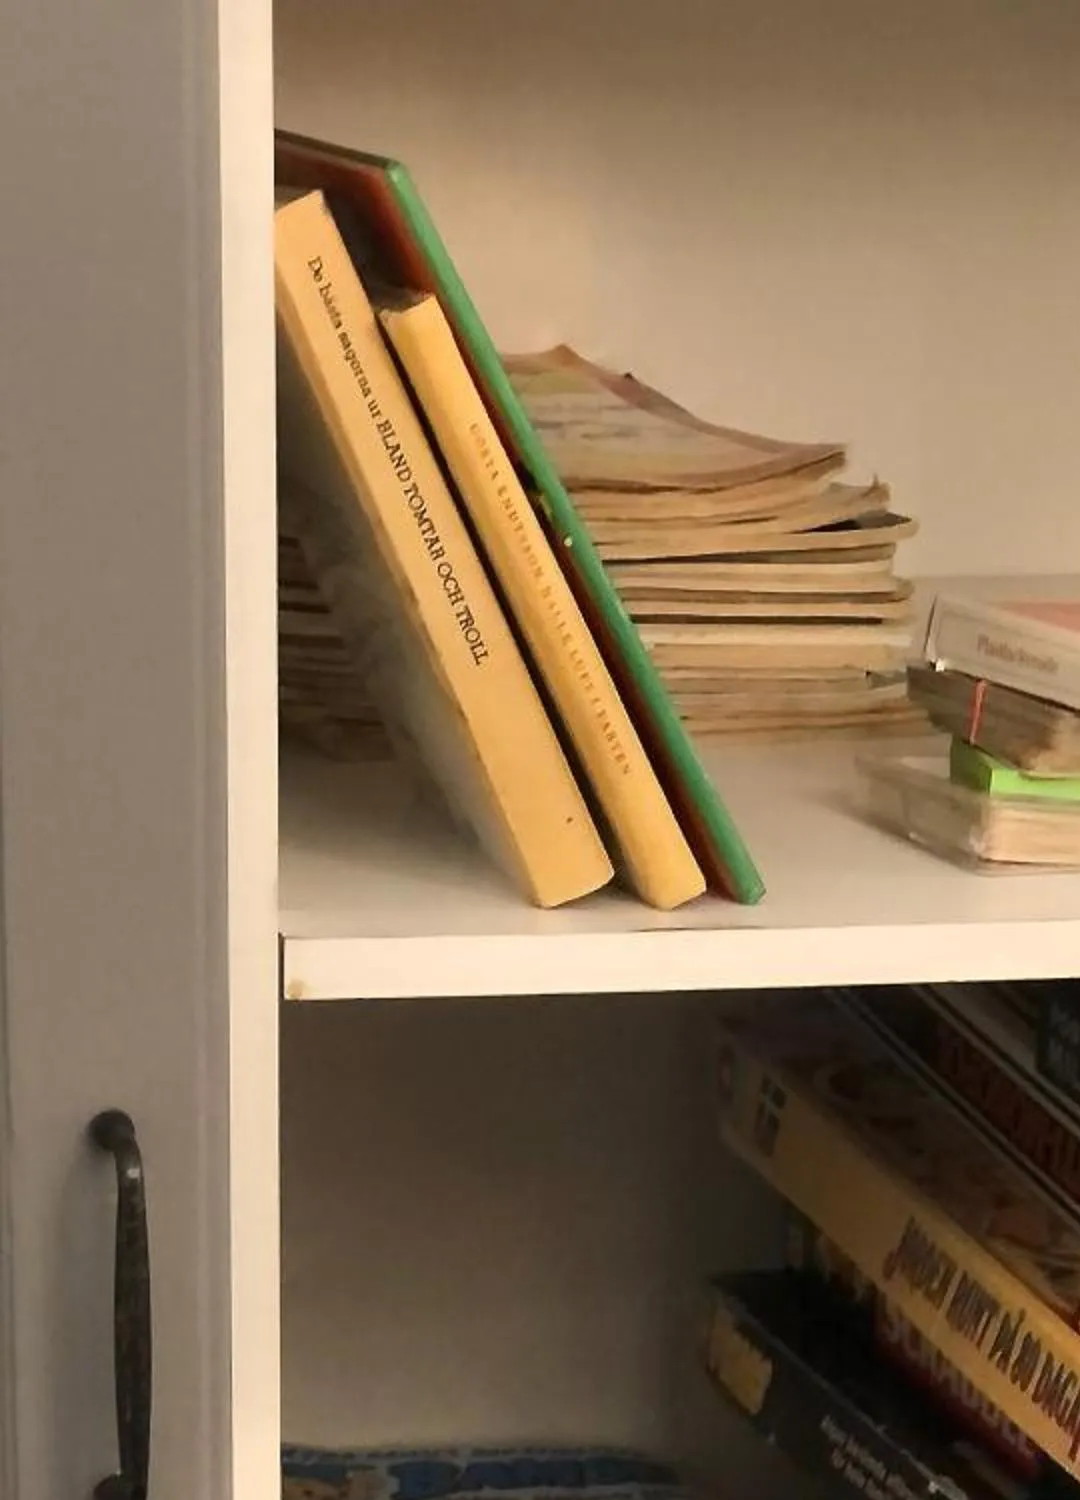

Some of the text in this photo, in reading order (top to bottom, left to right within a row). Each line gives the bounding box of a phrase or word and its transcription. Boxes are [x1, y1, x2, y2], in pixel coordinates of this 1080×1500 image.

[308, 256, 324, 282] De
[367, 400, 382, 418] ur
[376, 419, 411, 483] BLAND
[404, 483, 445, 561] TOMTAR
[438, 562, 465, 606] OCH
[456, 604, 489, 665] TROLL
